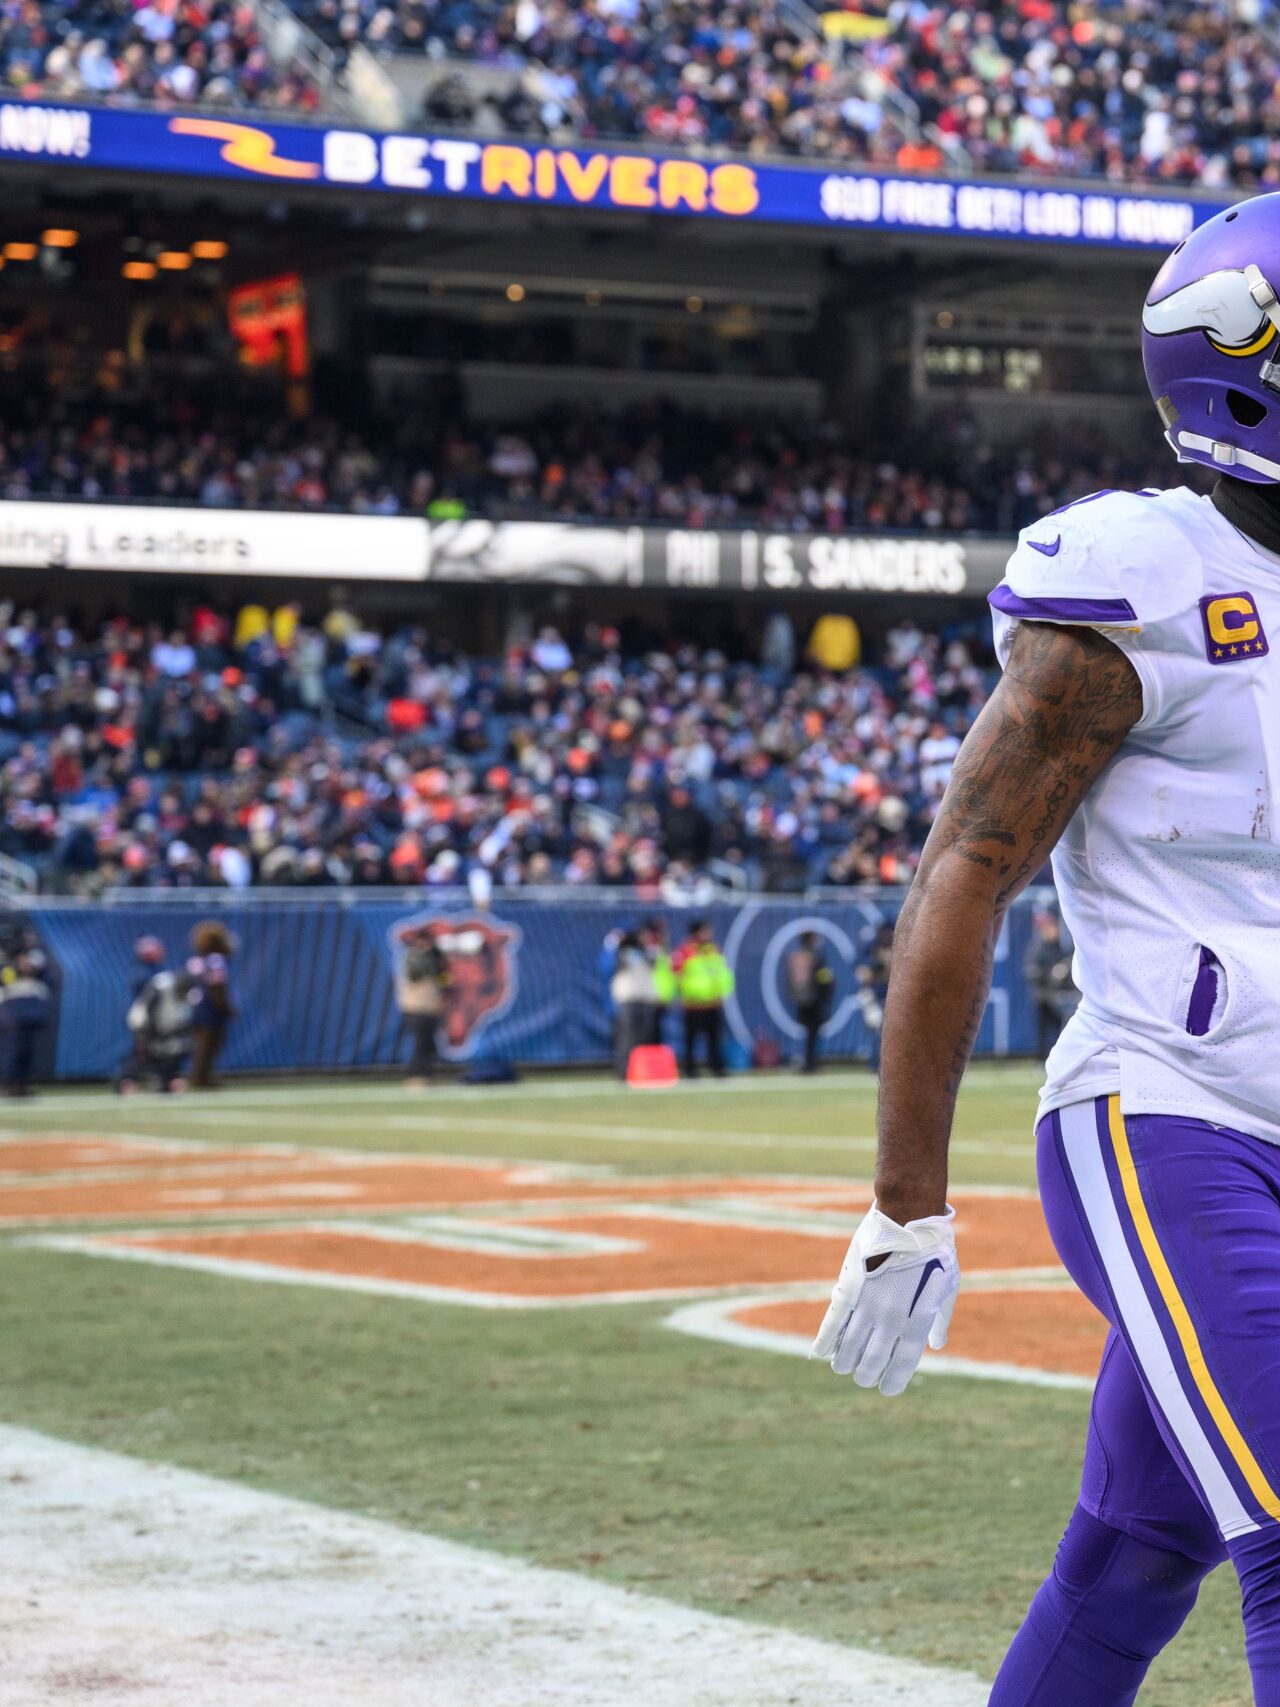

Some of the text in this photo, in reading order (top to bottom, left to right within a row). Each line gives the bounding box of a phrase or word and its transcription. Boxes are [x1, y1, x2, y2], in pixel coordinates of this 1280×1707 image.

[0, 105, 90, 157] NOW!
[324, 130, 760, 215] BETRIVERS
[883, 181, 952, 227] FREE
[86, 524, 252, 558] Leaders
[808, 536, 967, 594] SANDERS
[1206, 597, 1259, 645] C
